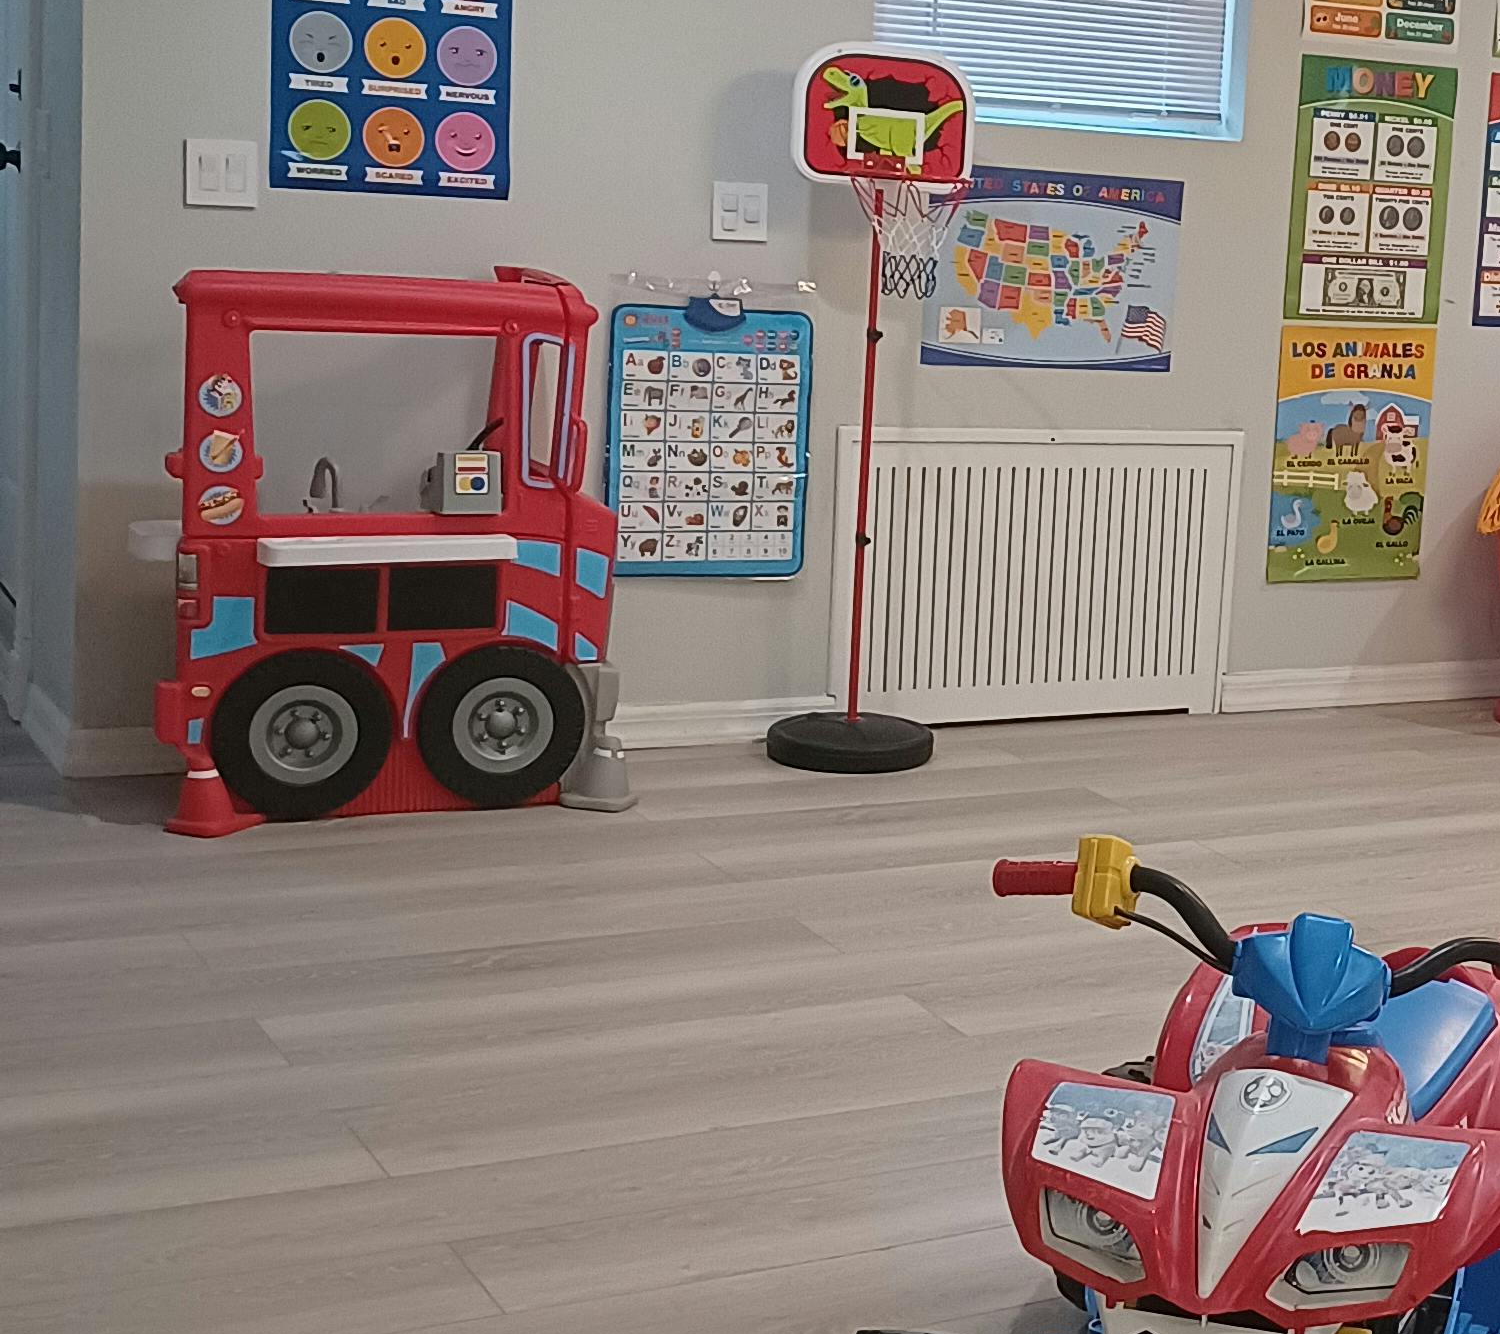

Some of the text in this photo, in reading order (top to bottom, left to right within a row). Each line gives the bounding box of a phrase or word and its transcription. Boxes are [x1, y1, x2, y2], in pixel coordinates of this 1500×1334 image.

[1396, 19, 1444, 32] December
[1326, 66, 1435, 99] MONEY
[446, 91, 489, 101] NERVOUS
[1012, 179, 1065, 196] STATES
[1099, 187, 1165, 203] AMERICA
[1292, 341, 1424, 359] LOS ANIMALES
[1311, 363, 1416, 380] DE GRANJA
